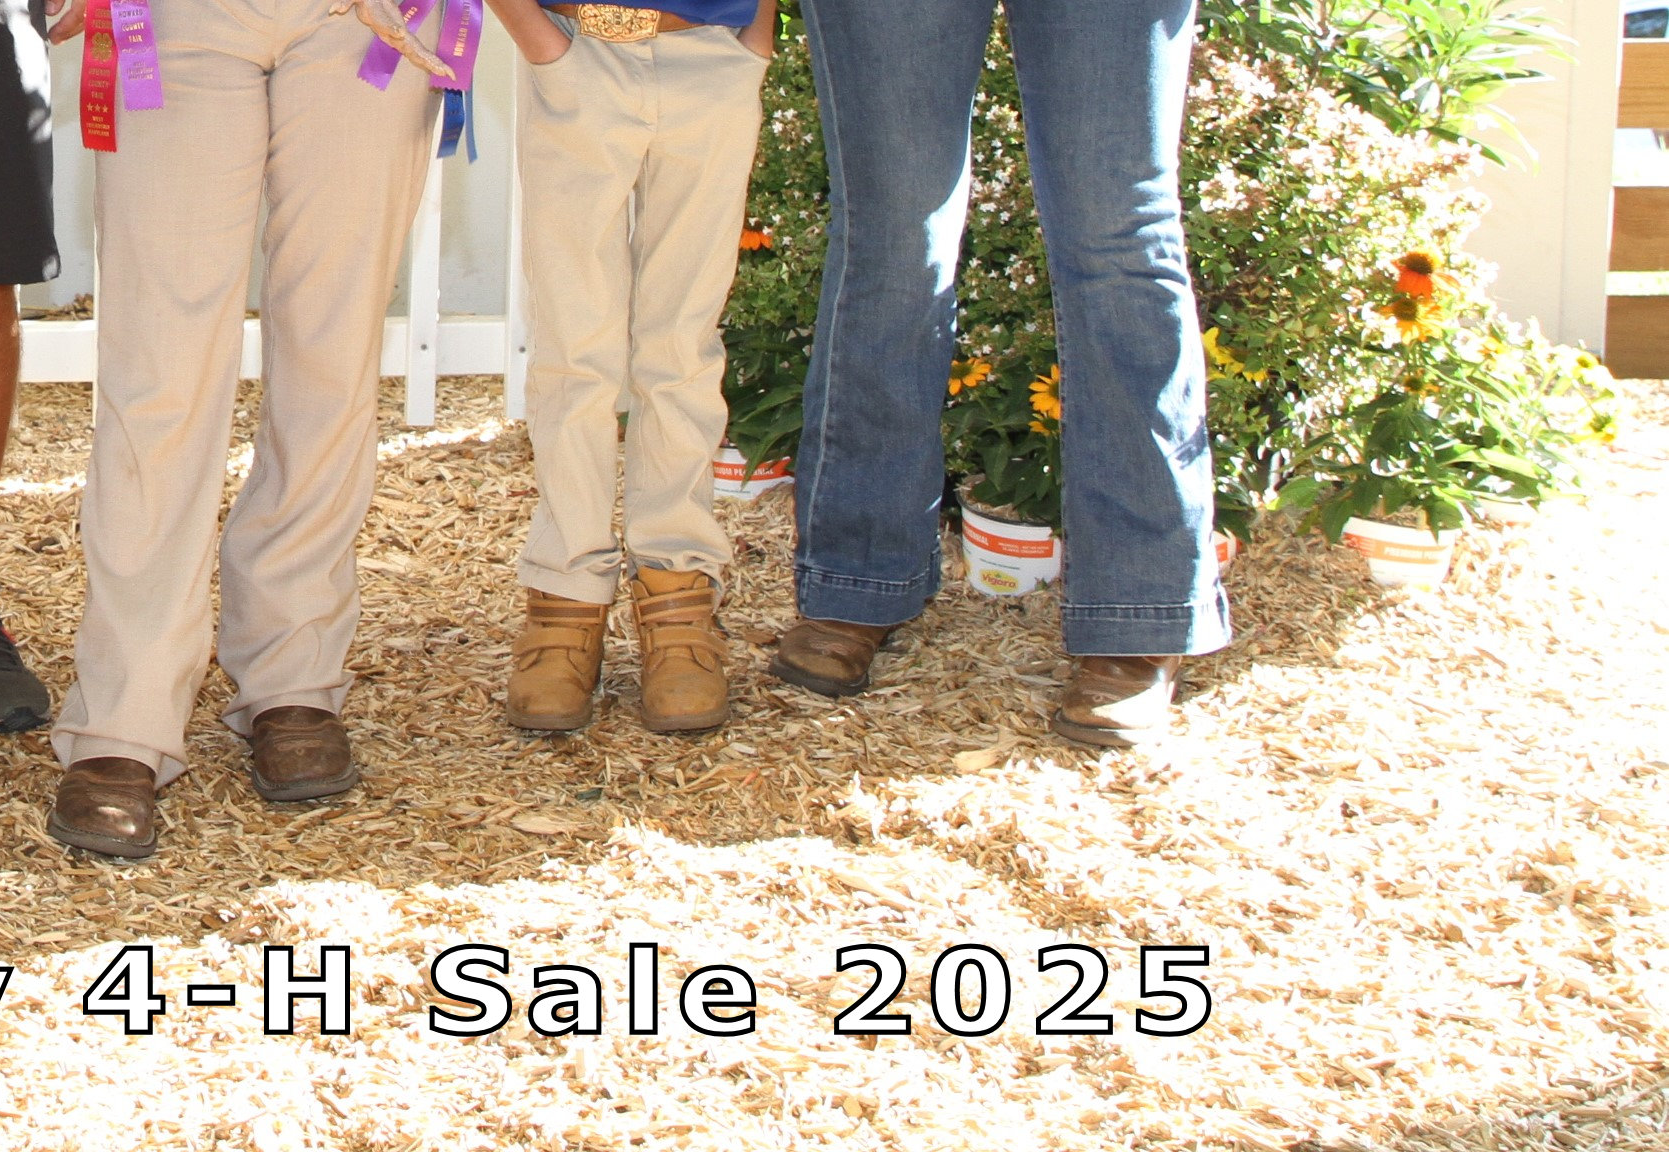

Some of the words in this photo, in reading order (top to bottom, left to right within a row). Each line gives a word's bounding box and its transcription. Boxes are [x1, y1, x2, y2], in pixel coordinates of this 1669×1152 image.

[118, 9, 143, 18] HOWARD
[121, 21, 145, 32] COUNTY
[128, 35, 143, 43] FAIR
[453, 28, 468, 57] HOWARD
